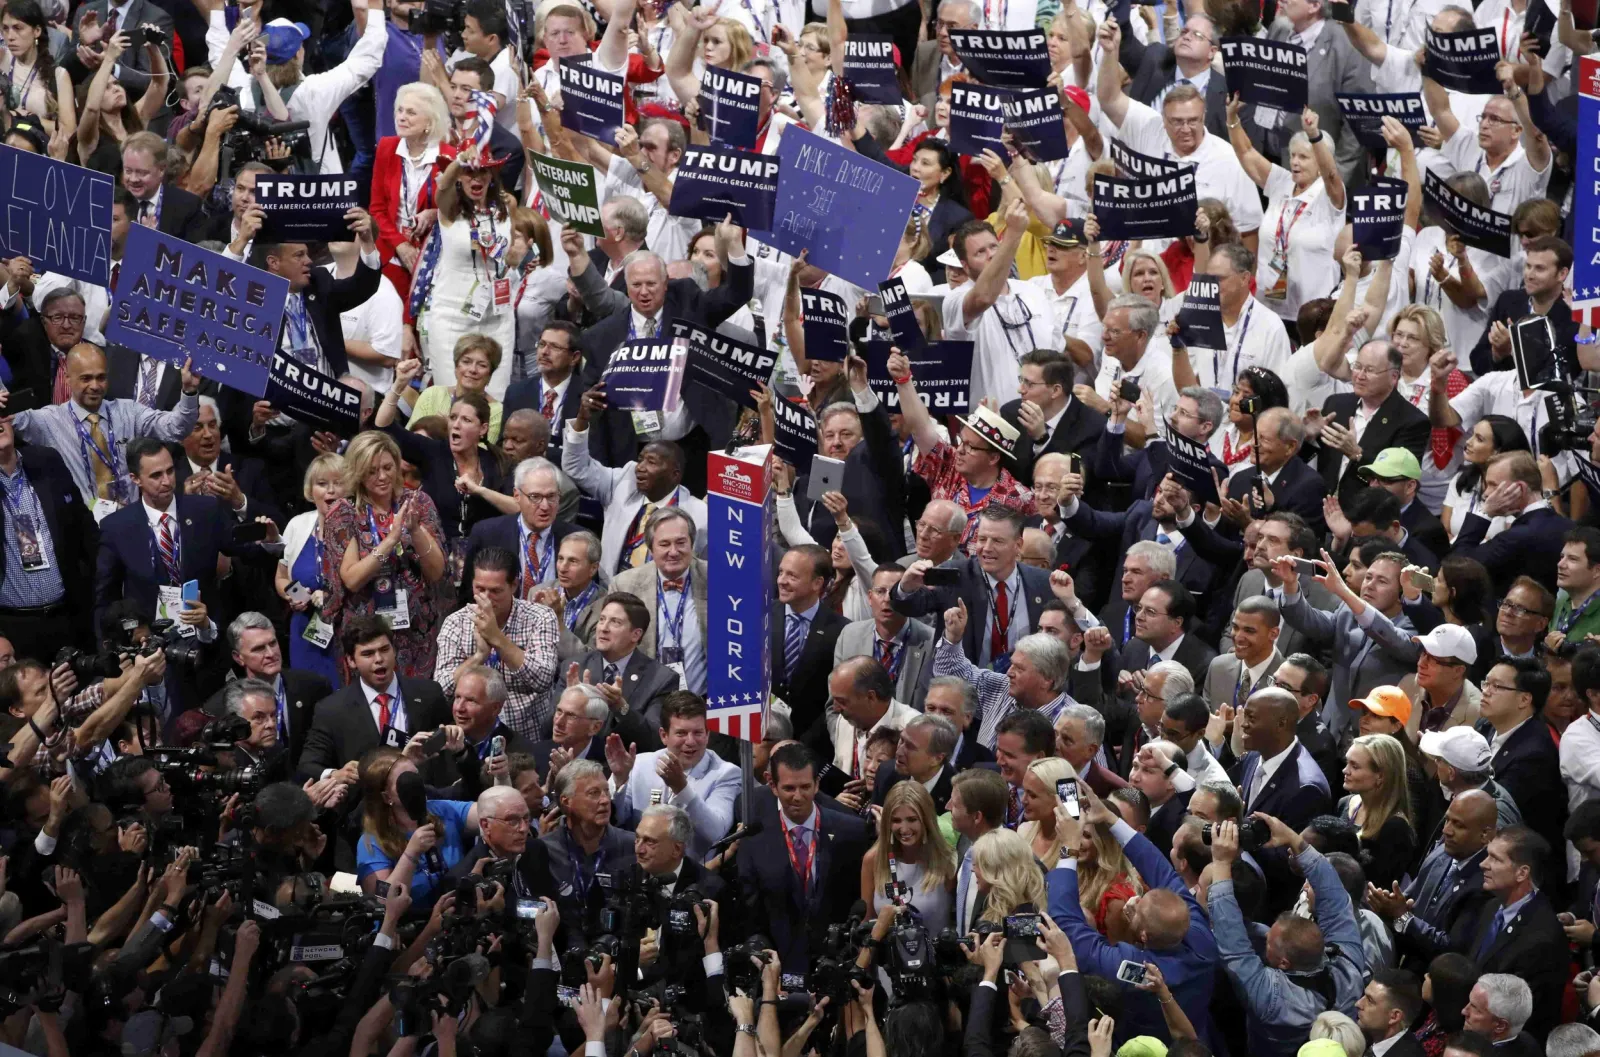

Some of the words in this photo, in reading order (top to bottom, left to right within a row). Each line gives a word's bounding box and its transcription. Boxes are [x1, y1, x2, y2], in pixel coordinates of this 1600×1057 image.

[844, 41, 893, 57] TRUMP
[950, 34, 1045, 50] TRUMP
[1427, 29, 1496, 52] RUMP
[1221, 42, 1307, 67] TRUMP
[1225, 60, 1244, 68] MAKE
[1245, 61, 1271, 72] AMERICA
[1271, 67, 1289, 75] GREAT
[560, 64, 623, 96] TRUMP
[703, 70, 760, 98] RUMP
[571, 88, 591, 100] AMERICA
[591, 95, 606, 104] GREAT
[719, 97, 736, 107] GREAT
[736, 102, 758, 111] AGAIN!
[952, 88, 1001, 111] TRU
[1338, 98, 1421, 113] TRUMP
[950, 108, 966, 117] MAKE
[966, 112, 993, 123] AMERICA
[1041, 113, 1062, 123] AGAIN!
[534, 159, 589, 187] VETERANS
[684, 151, 779, 178] TRUMP
[794, 143, 832, 177] MAKE
[834, 159, 884, 195] AMERICA
[257, 180, 358, 198] TRUMP
[552, 183, 571, 199] FOR
[678, 170, 697, 179] MAKE
[697, 173, 728, 184] AMERICA
[729, 179, 753, 188] GREAT
[754, 183, 777, 192] AGAIN!
[1095, 173, 1194, 199] TRUMP
[12, 154, 112, 232] LOVE
[1094, 199, 1113, 208] MAKE
[1149, 199, 1171, 208] GREAT
[1173, 192, 1196, 204] AGAIN!
[1353, 192, 1408, 211] TRU
[1426, 172, 1510, 226] TRUMP
[335, 201, 358, 209] AGAIN!
[541, 192, 600, 224] TRUMP
[1354, 216, 1375, 224] MAKE
[1463, 217, 1484, 228] GREAT
[0, 204, 108, 280] ELANIA
[155, 242, 266, 307] MAKE
[130, 273, 274, 341] AMERICA
[802, 294, 847, 318] TRU
[804, 314, 823, 323] MAKE
[117, 300, 187, 339] SAFE
[197, 331, 270, 369] AGAIN
[672, 323, 774, 369] TRUMP
[608, 344, 687, 365] TRUMP
[689, 345, 718, 363] AMERICA
[720, 360, 742, 373] GREAT
[742, 371, 768, 382] AGAIN!
[273, 353, 360, 406] TRUMP
[640, 365, 660, 373] GREAT
[920, 379, 949, 387] AMERICA
[269, 372, 284, 386] MAKE
[283, 382, 312, 400] AMERICA
[312, 397, 334, 409] GREAT
[334, 406, 359, 419] AGAIN!
[775, 396, 816, 430] UMP
[780, 422, 796, 435] GREAT
[1167, 428, 1207, 460] UMP
[723, 486, 752, 496] CLEVELAND
[726, 505, 745, 569] NEW
[727, 595, 743, 682] YORK
